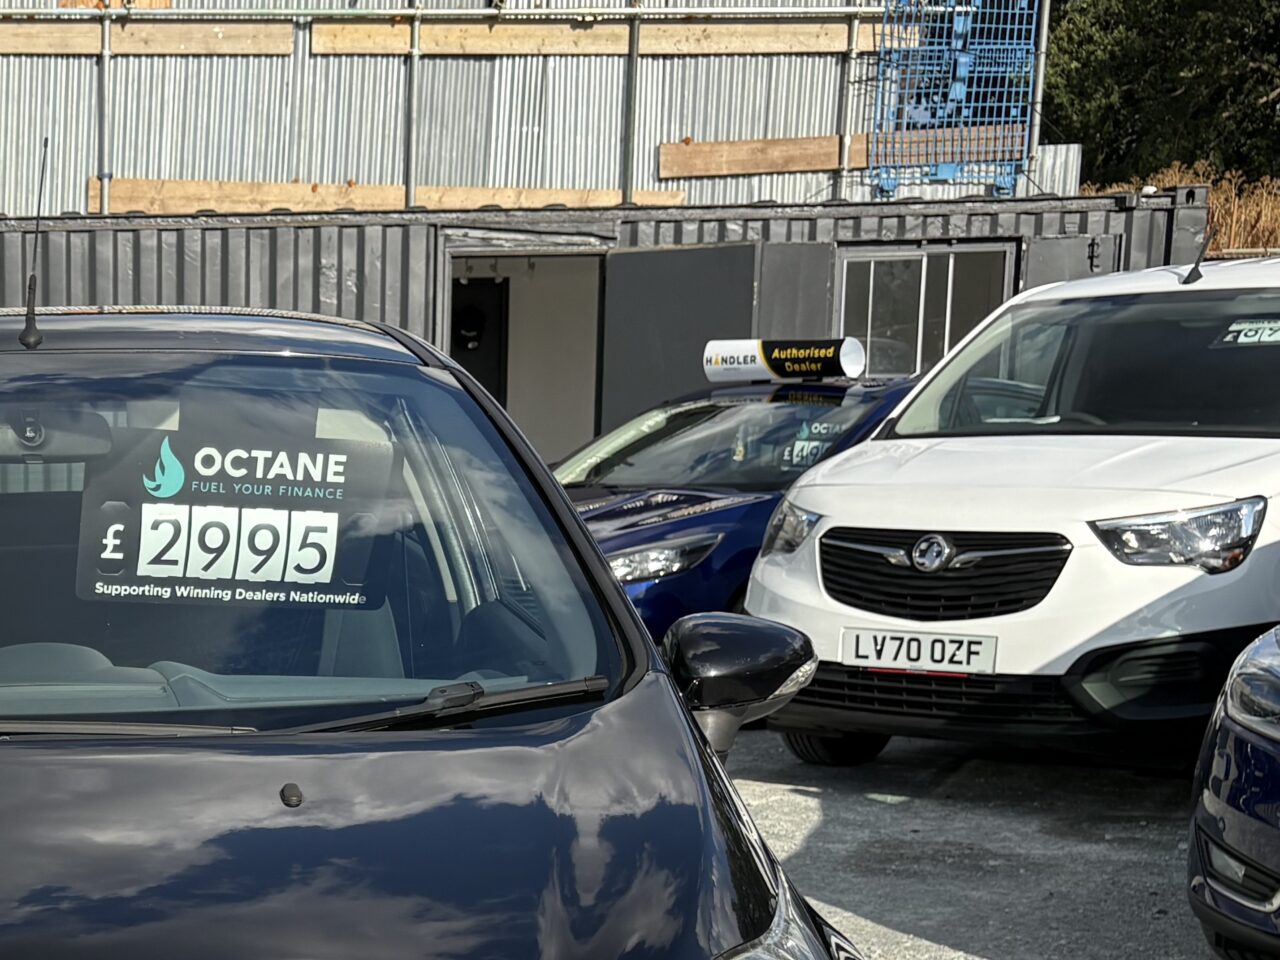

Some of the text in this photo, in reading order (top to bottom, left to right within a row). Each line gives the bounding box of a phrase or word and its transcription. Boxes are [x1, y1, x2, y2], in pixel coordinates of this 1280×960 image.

[771, 346, 835, 359] Authorised
[784, 361, 823, 373] Dealer
[194, 447, 348, 483] OCTANE
[191, 481, 344, 500] FUEL YOUR FINANCE
[95, 581, 367, 605] Supporting Winning Dealers Nationwide
[854, 634, 983, 666] LV70 OZF
